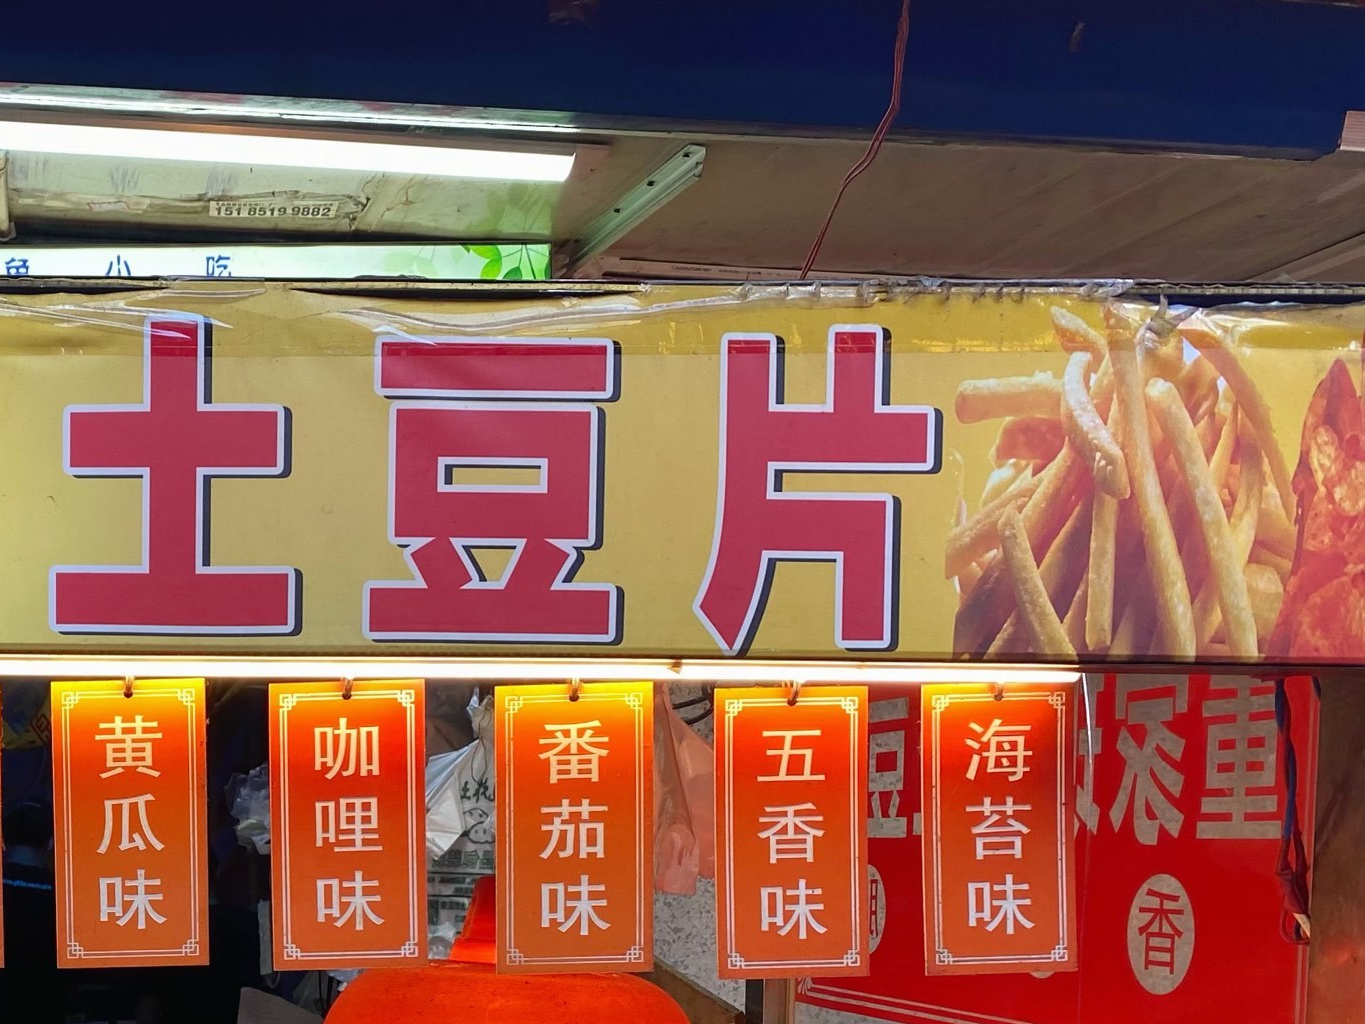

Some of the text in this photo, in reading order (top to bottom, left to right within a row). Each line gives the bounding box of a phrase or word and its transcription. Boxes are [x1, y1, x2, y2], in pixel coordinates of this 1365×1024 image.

[215, 206, 332, 217] 151 8519 9882
[94, 715, 167, 930] 黄瓜味
[313, 717, 385, 931] 咖哩味
[538, 719, 612, 936] 番茄味
[756, 730, 828, 939] 五香味
[965, 718, 1035, 935] 海苔味
